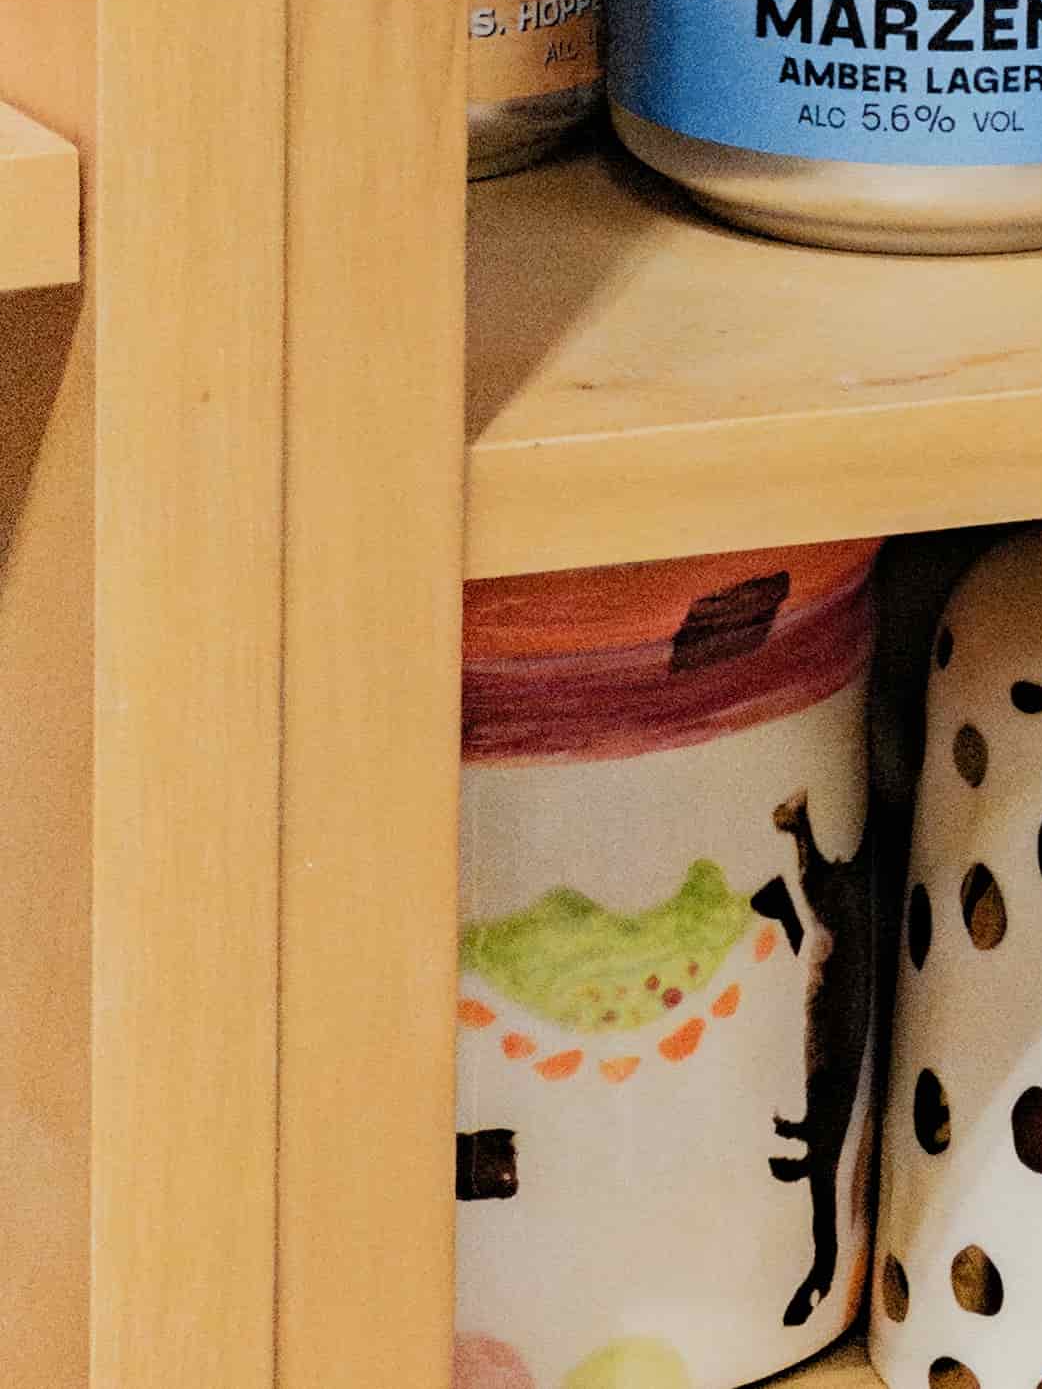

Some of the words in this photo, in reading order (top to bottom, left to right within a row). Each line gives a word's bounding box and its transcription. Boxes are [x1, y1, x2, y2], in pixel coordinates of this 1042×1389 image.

[779, 56, 907, 93] AMBER
[798, 104, 846, 129] ALC
[861, 103, 956, 133] 5.6%
[973, 111, 1025, 133] VOL
